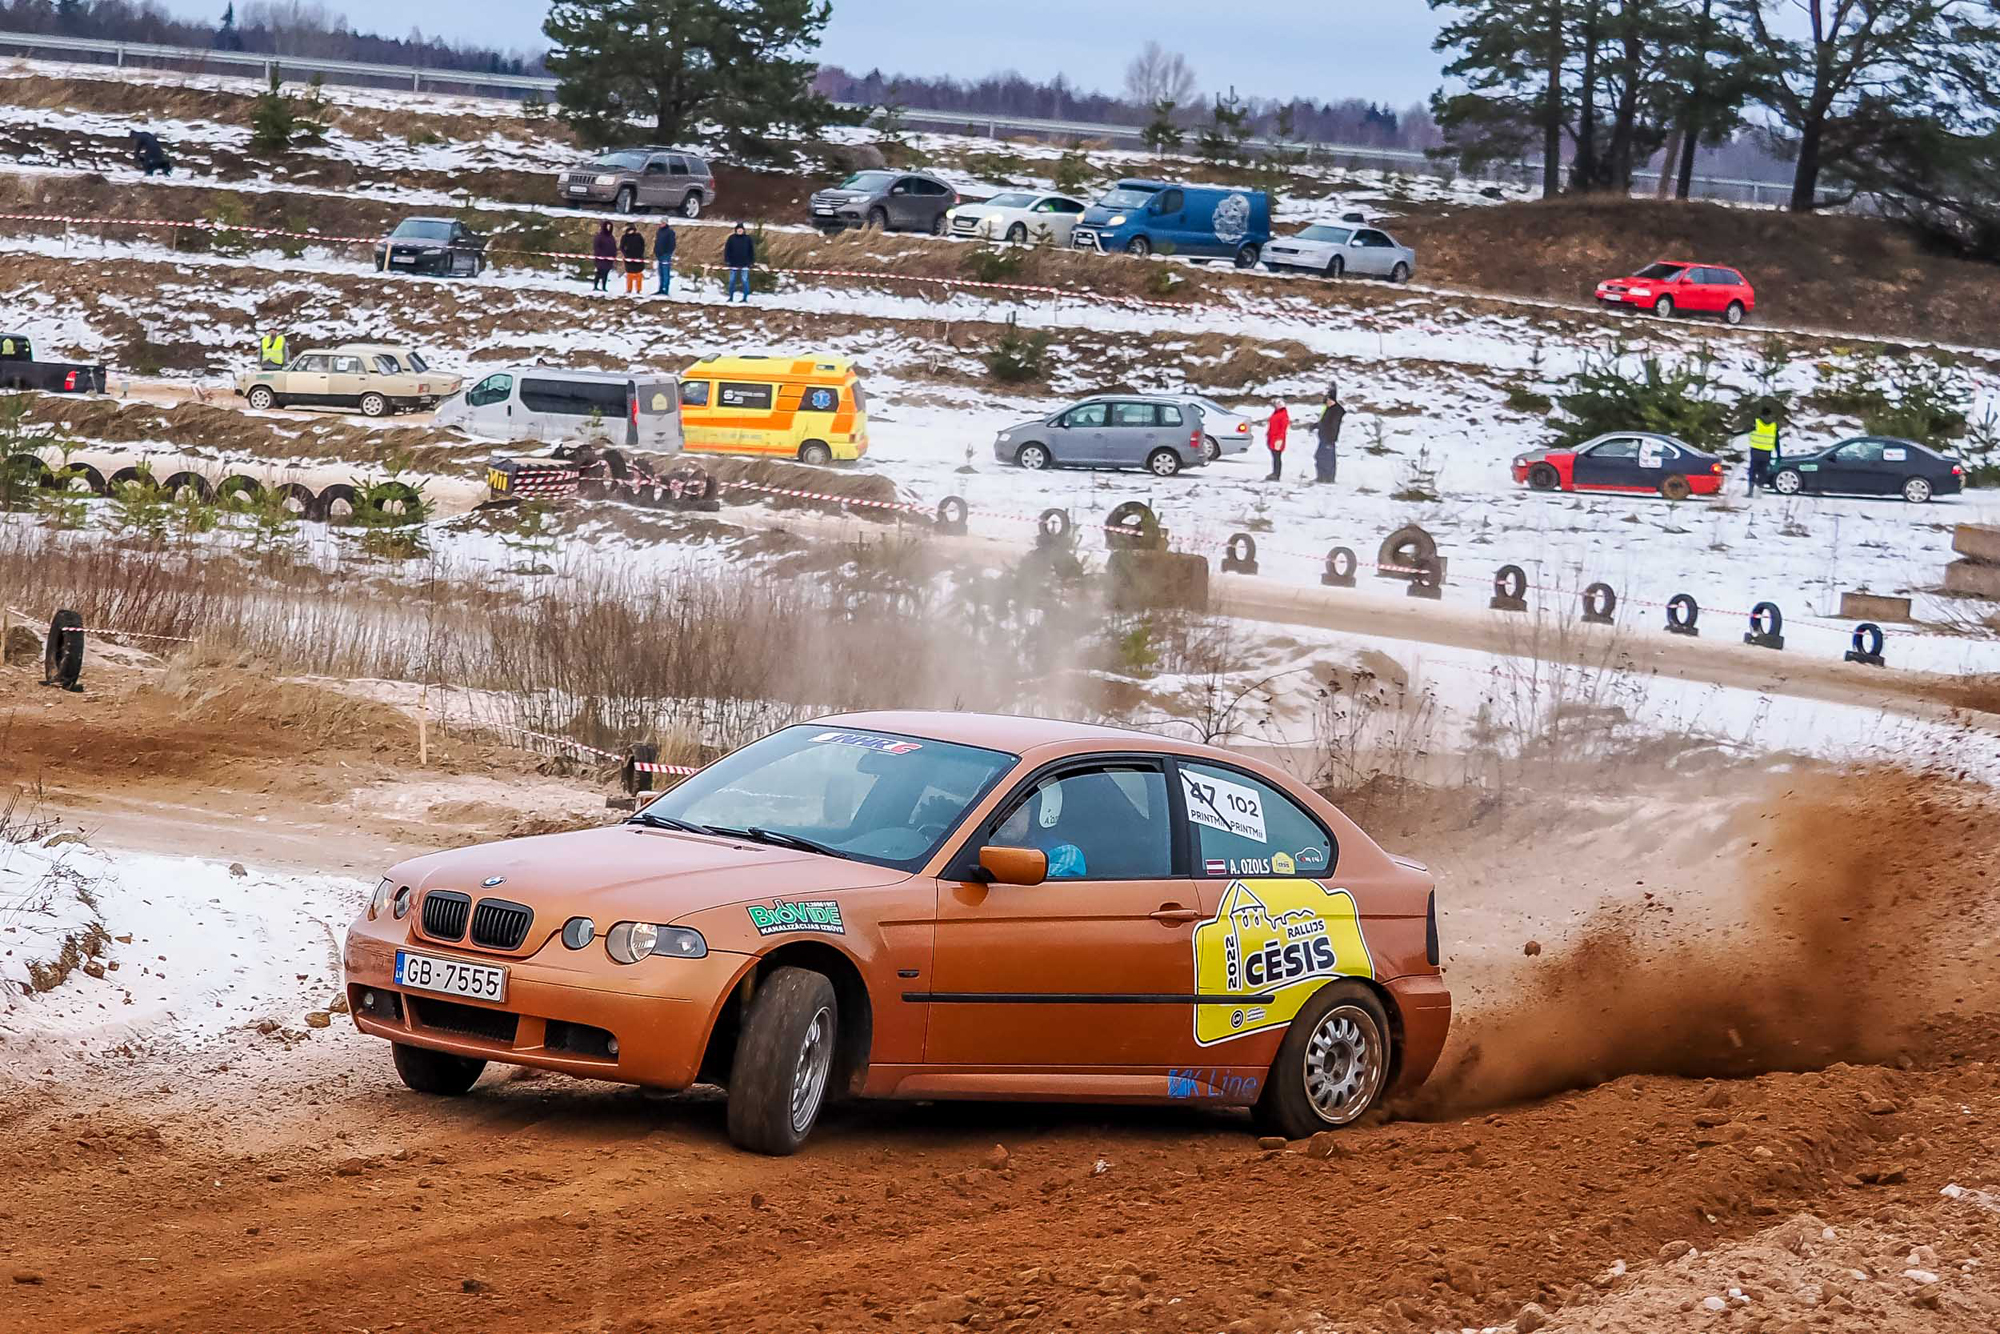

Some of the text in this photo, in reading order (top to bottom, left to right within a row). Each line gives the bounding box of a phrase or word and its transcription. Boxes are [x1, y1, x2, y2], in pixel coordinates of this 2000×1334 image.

[1227, 794, 1259, 818] 102
[1230, 820, 1264, 839] PRINTMii
[1287, 920, 1325, 939] RALLIJS
[1226, 936, 1238, 990] 2022
[1245, 937, 1335, 986] CĒSIS
[1208, 1069, 1258, 1098] Line
